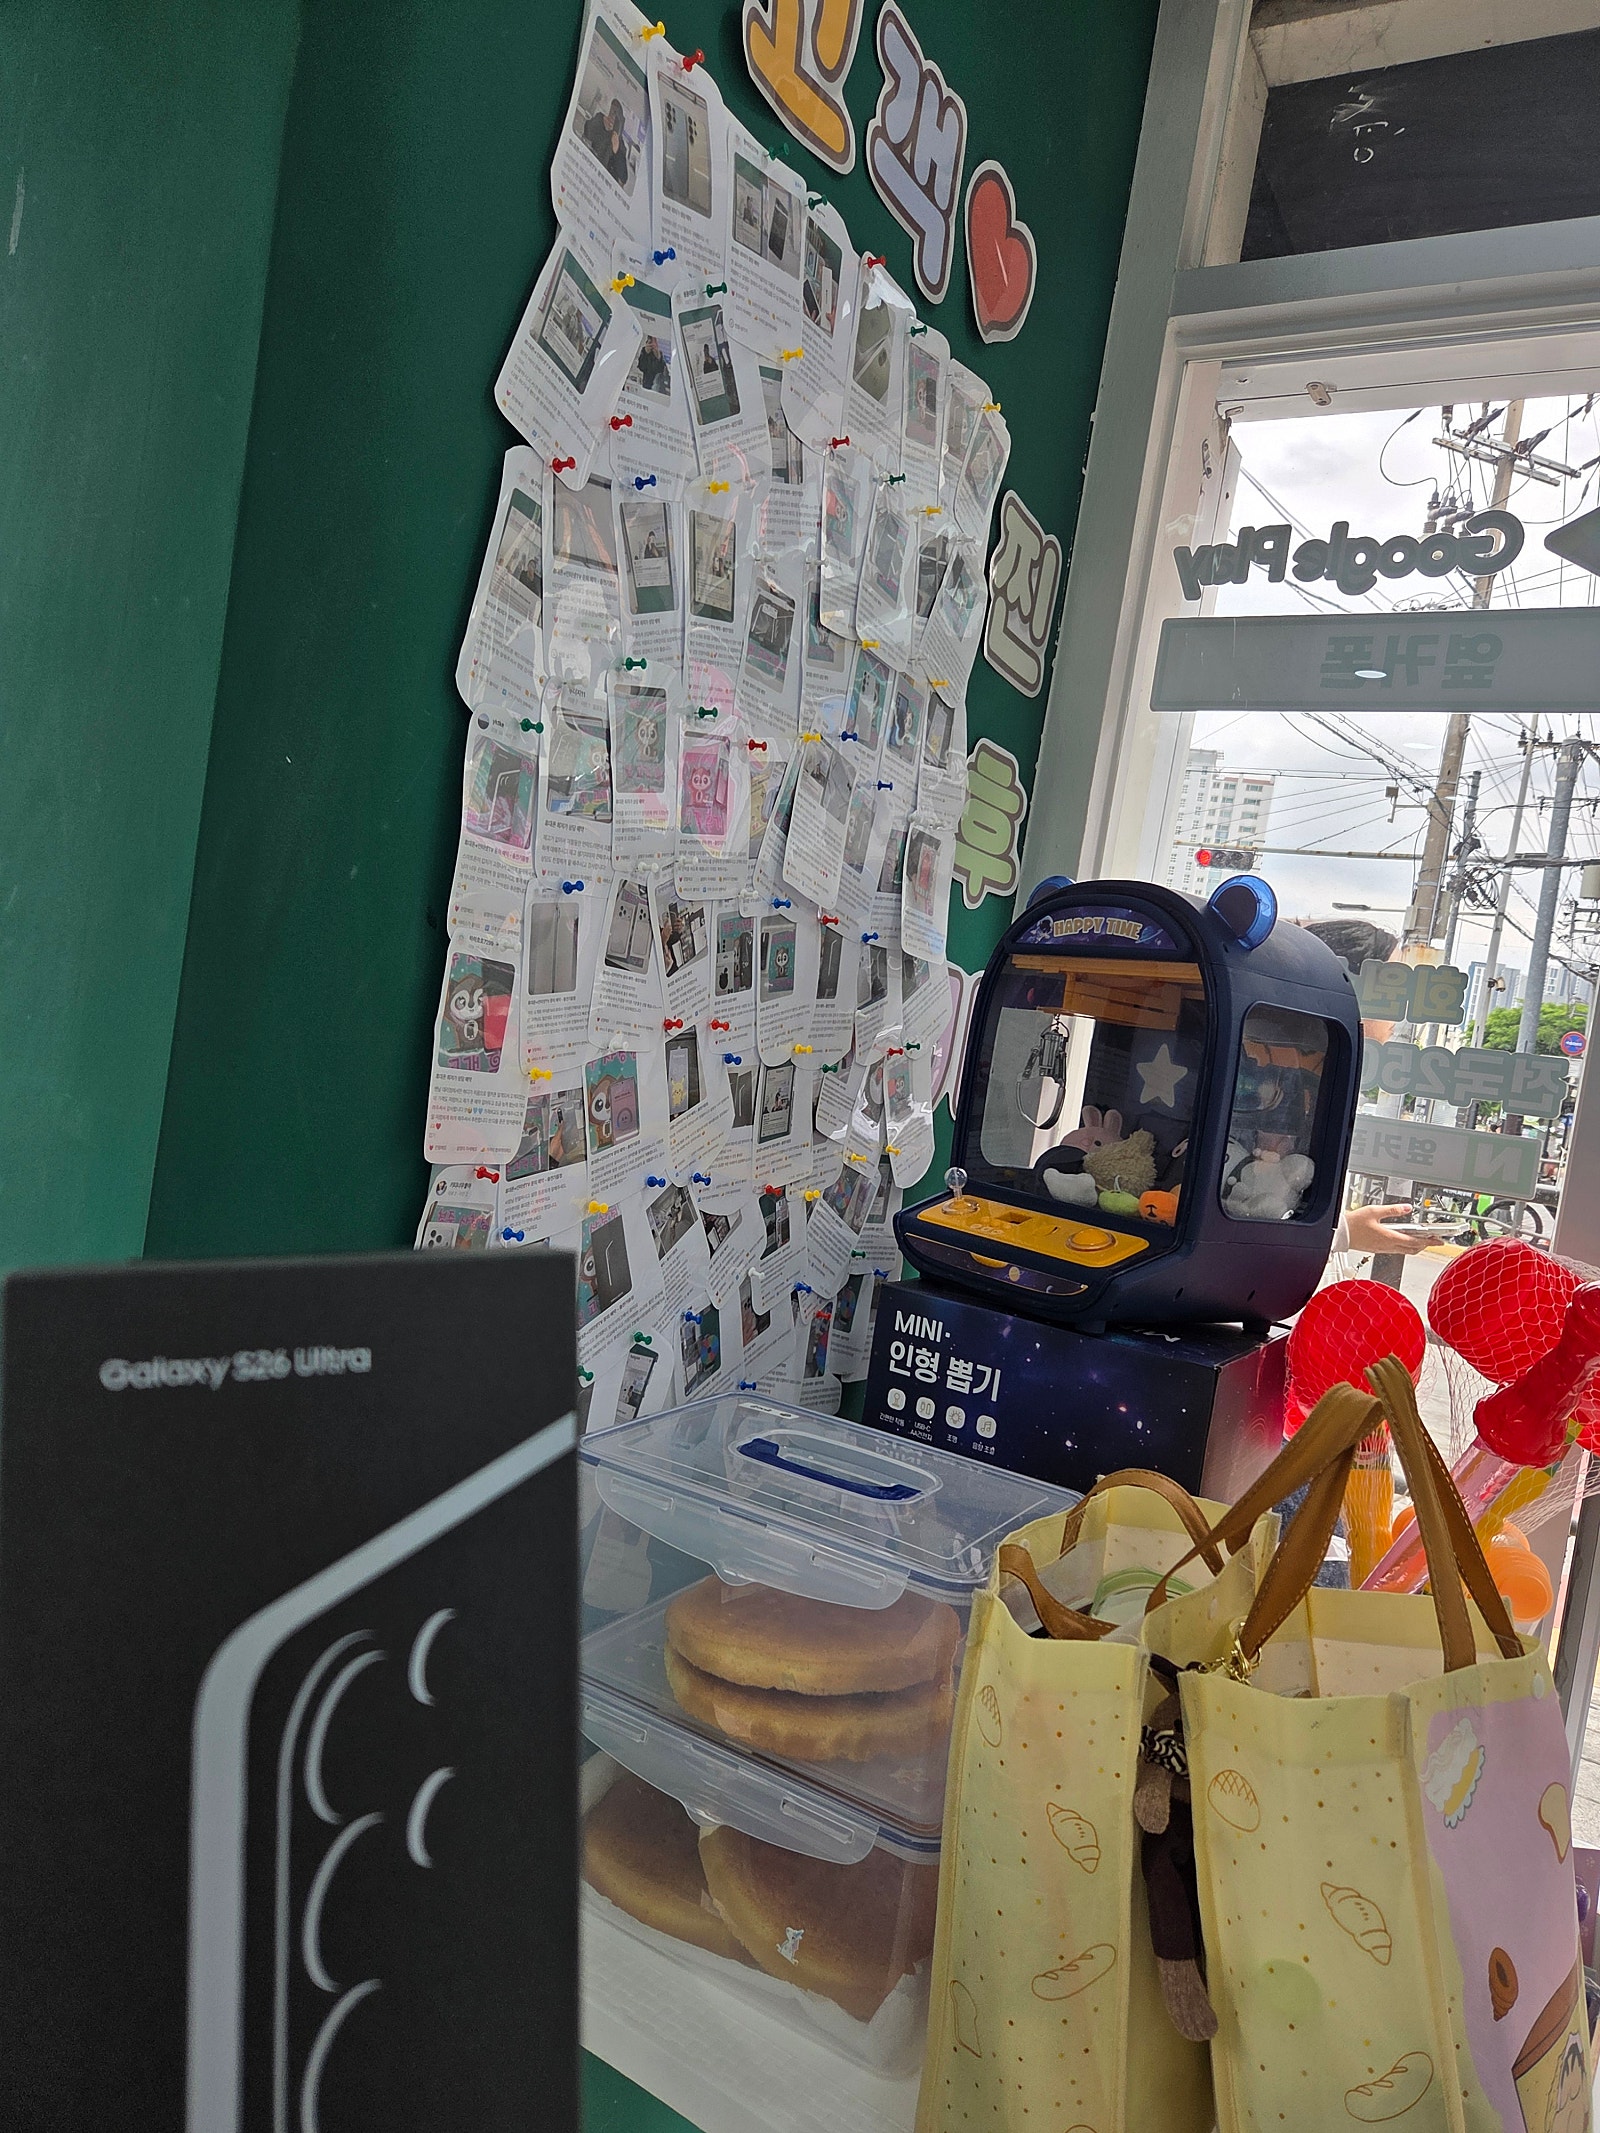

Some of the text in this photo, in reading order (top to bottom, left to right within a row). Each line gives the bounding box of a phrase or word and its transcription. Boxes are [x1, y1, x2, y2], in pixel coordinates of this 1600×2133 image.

[1054, 918, 1143, 940] HAPPY TIME
[99, 1346, 372, 1390] Galaxy S26 Ultra
[889, 1340, 1002, 1402] 인형 뽑기
[914, 1421, 931, 1432] USB-C
